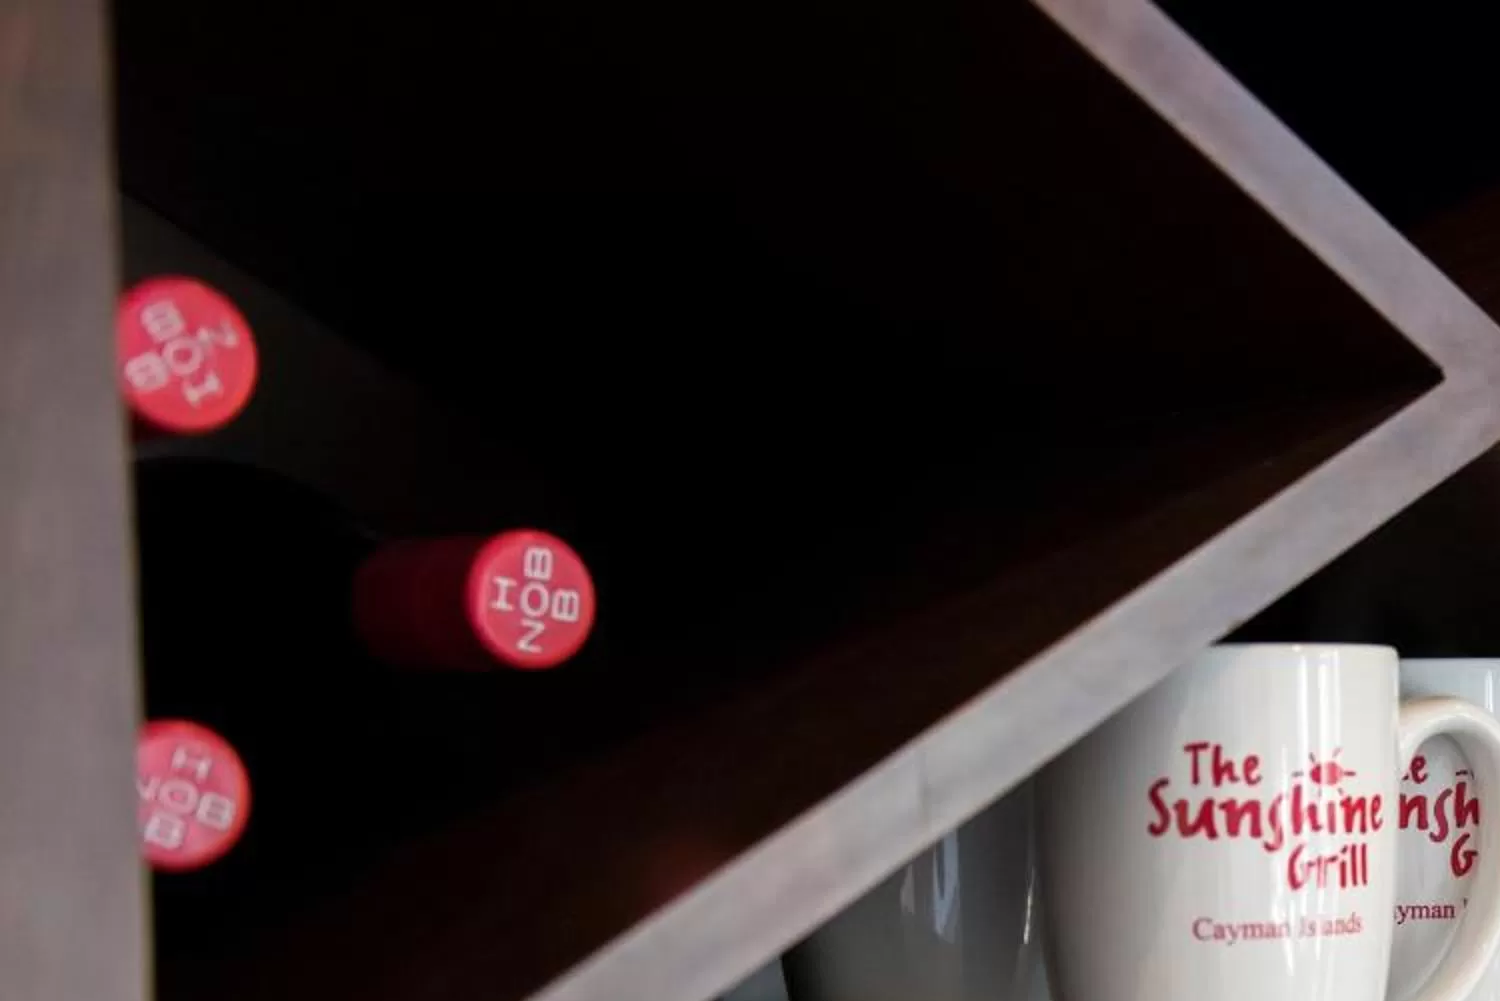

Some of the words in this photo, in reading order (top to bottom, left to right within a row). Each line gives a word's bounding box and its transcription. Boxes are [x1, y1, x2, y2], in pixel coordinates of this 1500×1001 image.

[1182, 740, 1262, 788] The
[1147, 776, 1384, 853] Sunshine
[1286, 842, 1369, 891] Grill
[1191, 914, 1291, 946] Cayman
[1299, 911, 1365, 940] Isands
